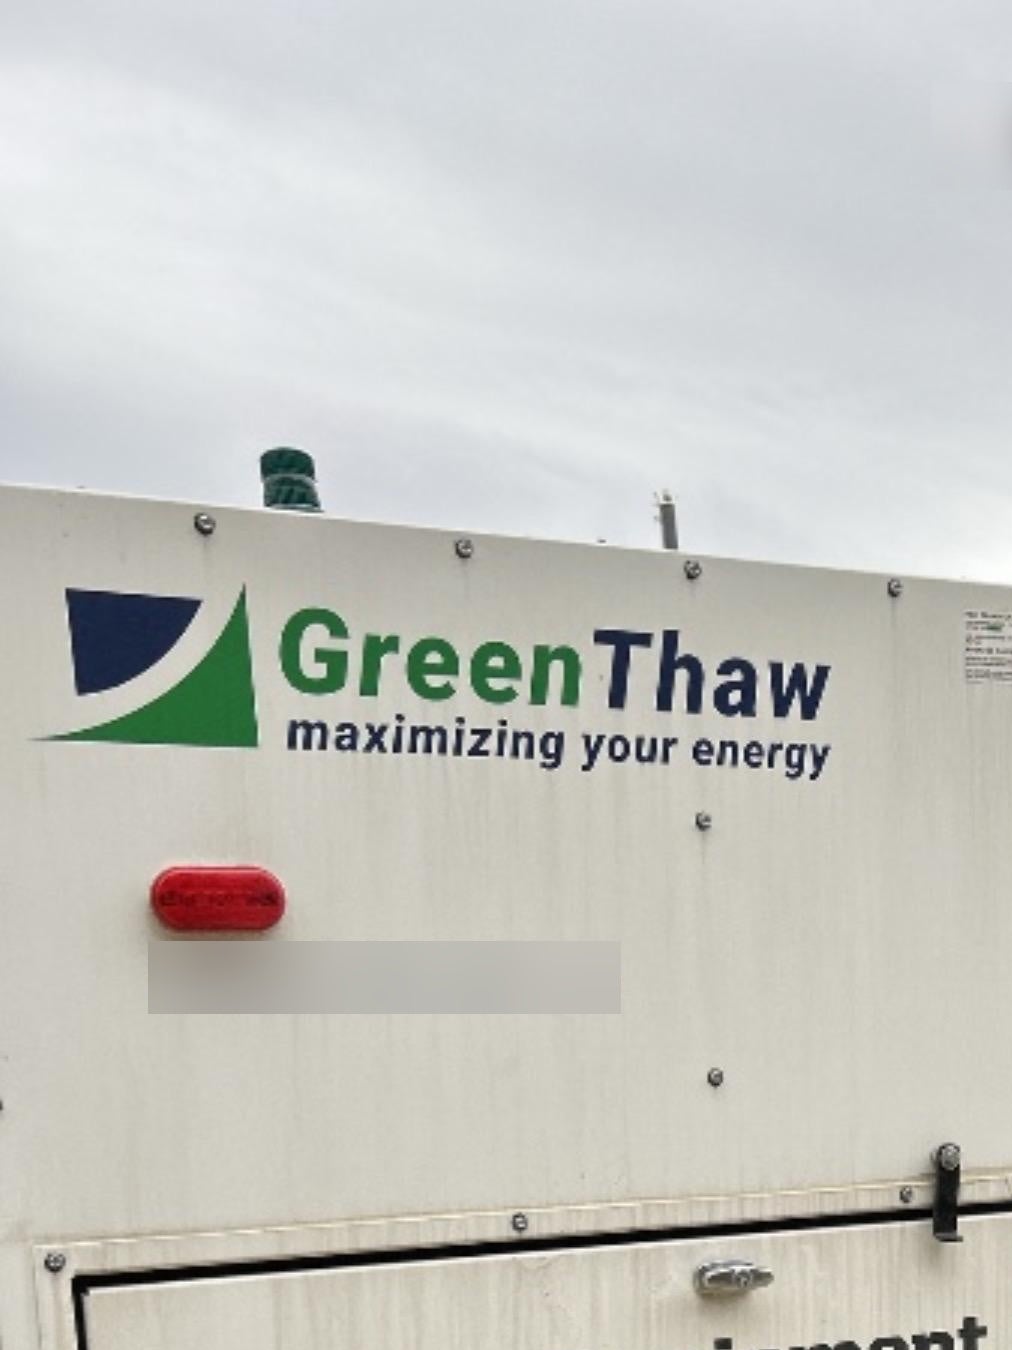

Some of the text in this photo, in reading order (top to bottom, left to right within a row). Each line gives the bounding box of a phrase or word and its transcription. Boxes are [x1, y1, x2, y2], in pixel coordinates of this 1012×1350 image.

[279, 606, 832, 722] GreenThaw
[287, 713, 832, 782] maximizing your energy
